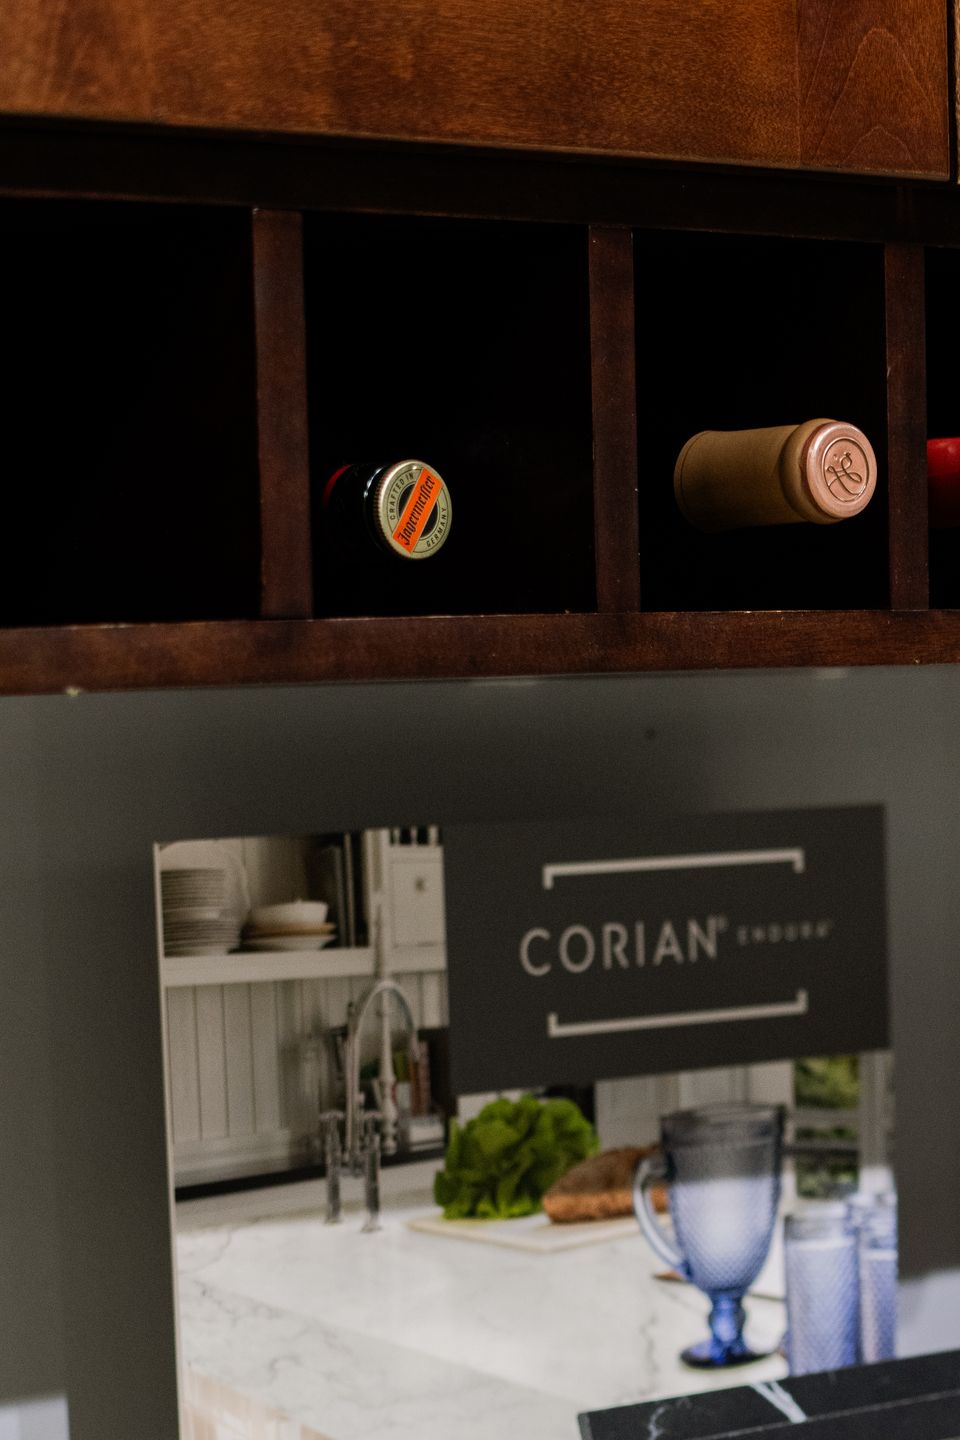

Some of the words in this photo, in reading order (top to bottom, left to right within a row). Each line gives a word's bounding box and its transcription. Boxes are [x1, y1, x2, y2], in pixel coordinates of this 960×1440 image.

[389, 479, 404, 521] CRAFTED
[405, 472, 414, 481] IN
[426, 508, 447, 548] GERMANY
[519, 918, 718, 976] CORIAN
